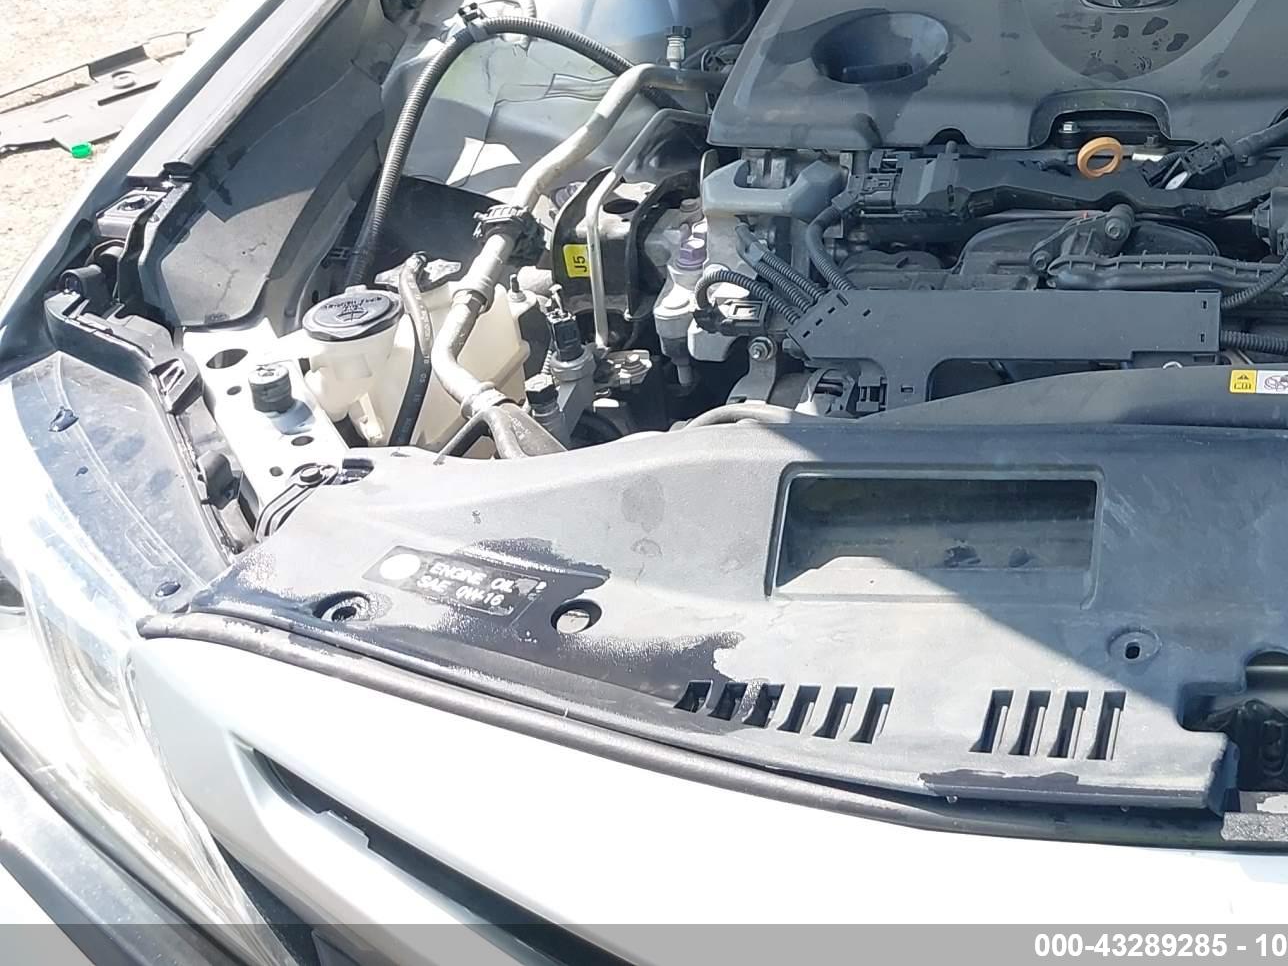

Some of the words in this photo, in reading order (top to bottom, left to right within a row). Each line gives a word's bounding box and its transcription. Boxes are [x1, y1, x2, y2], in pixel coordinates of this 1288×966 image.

[572, 255, 587, 273] J5
[429, 561, 488, 586] ENGINE
[416, 575, 452, 593] SAE
